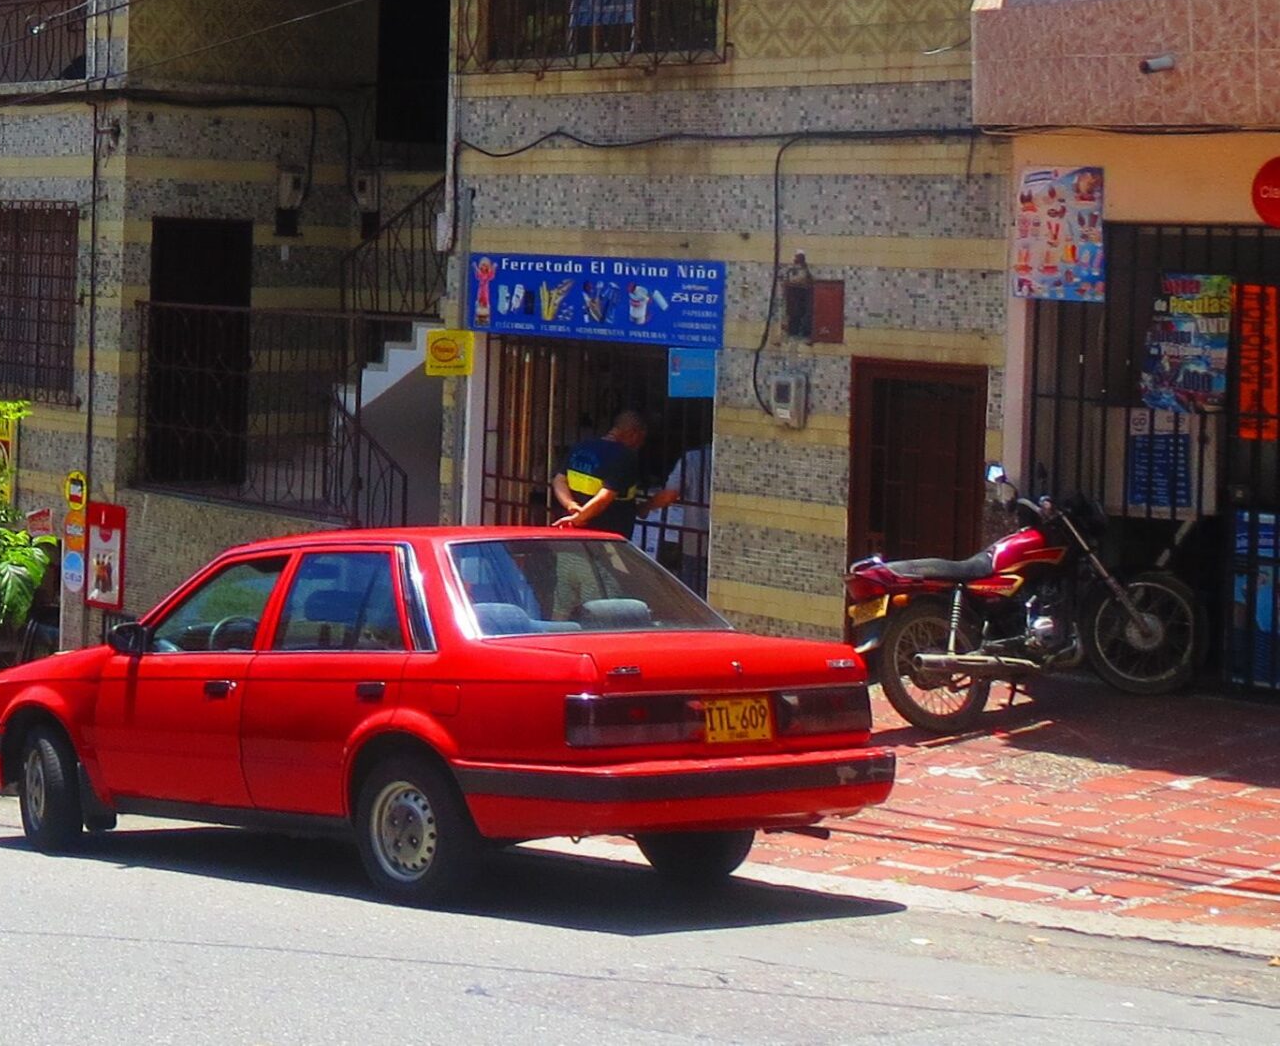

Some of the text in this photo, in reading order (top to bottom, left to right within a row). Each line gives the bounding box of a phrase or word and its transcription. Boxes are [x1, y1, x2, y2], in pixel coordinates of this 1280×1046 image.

[590, 259, 606, 275] El
[613, 260, 669, 278] Divino
[676, 264, 718, 280] Niño
